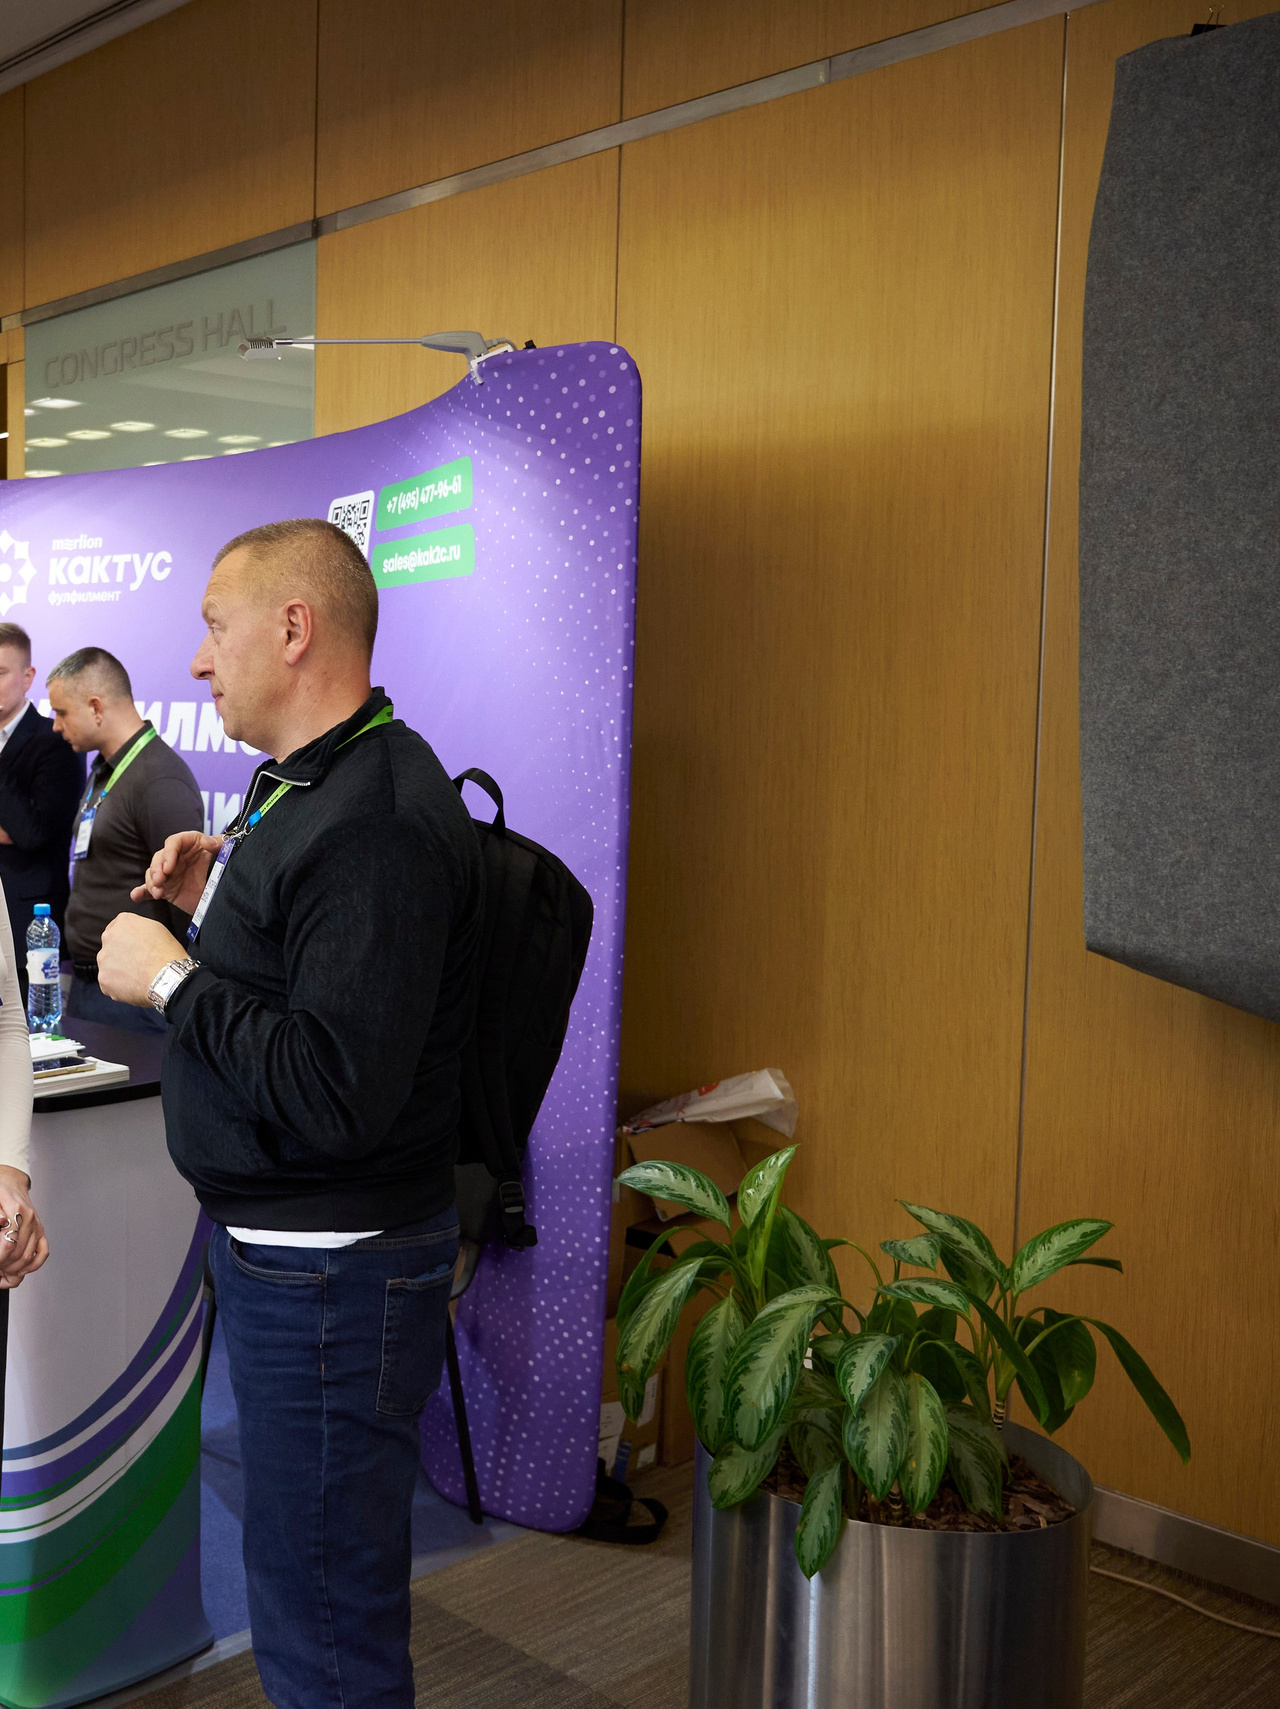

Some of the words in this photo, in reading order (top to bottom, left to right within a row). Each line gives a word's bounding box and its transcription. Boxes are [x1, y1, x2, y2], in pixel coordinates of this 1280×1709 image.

[44, 320, 194, 389] CONGRESS
[201, 299, 287, 351] HALL
[386, 496, 398, 514] +7
[398, 487, 419, 515] (495)
[420, 474, 462, 504] 477-96-61
[51, 534, 103, 551] merlion
[382, 544, 461, 573] sales@kak2c.ru
[48, 590, 122, 606] фулфилмент
